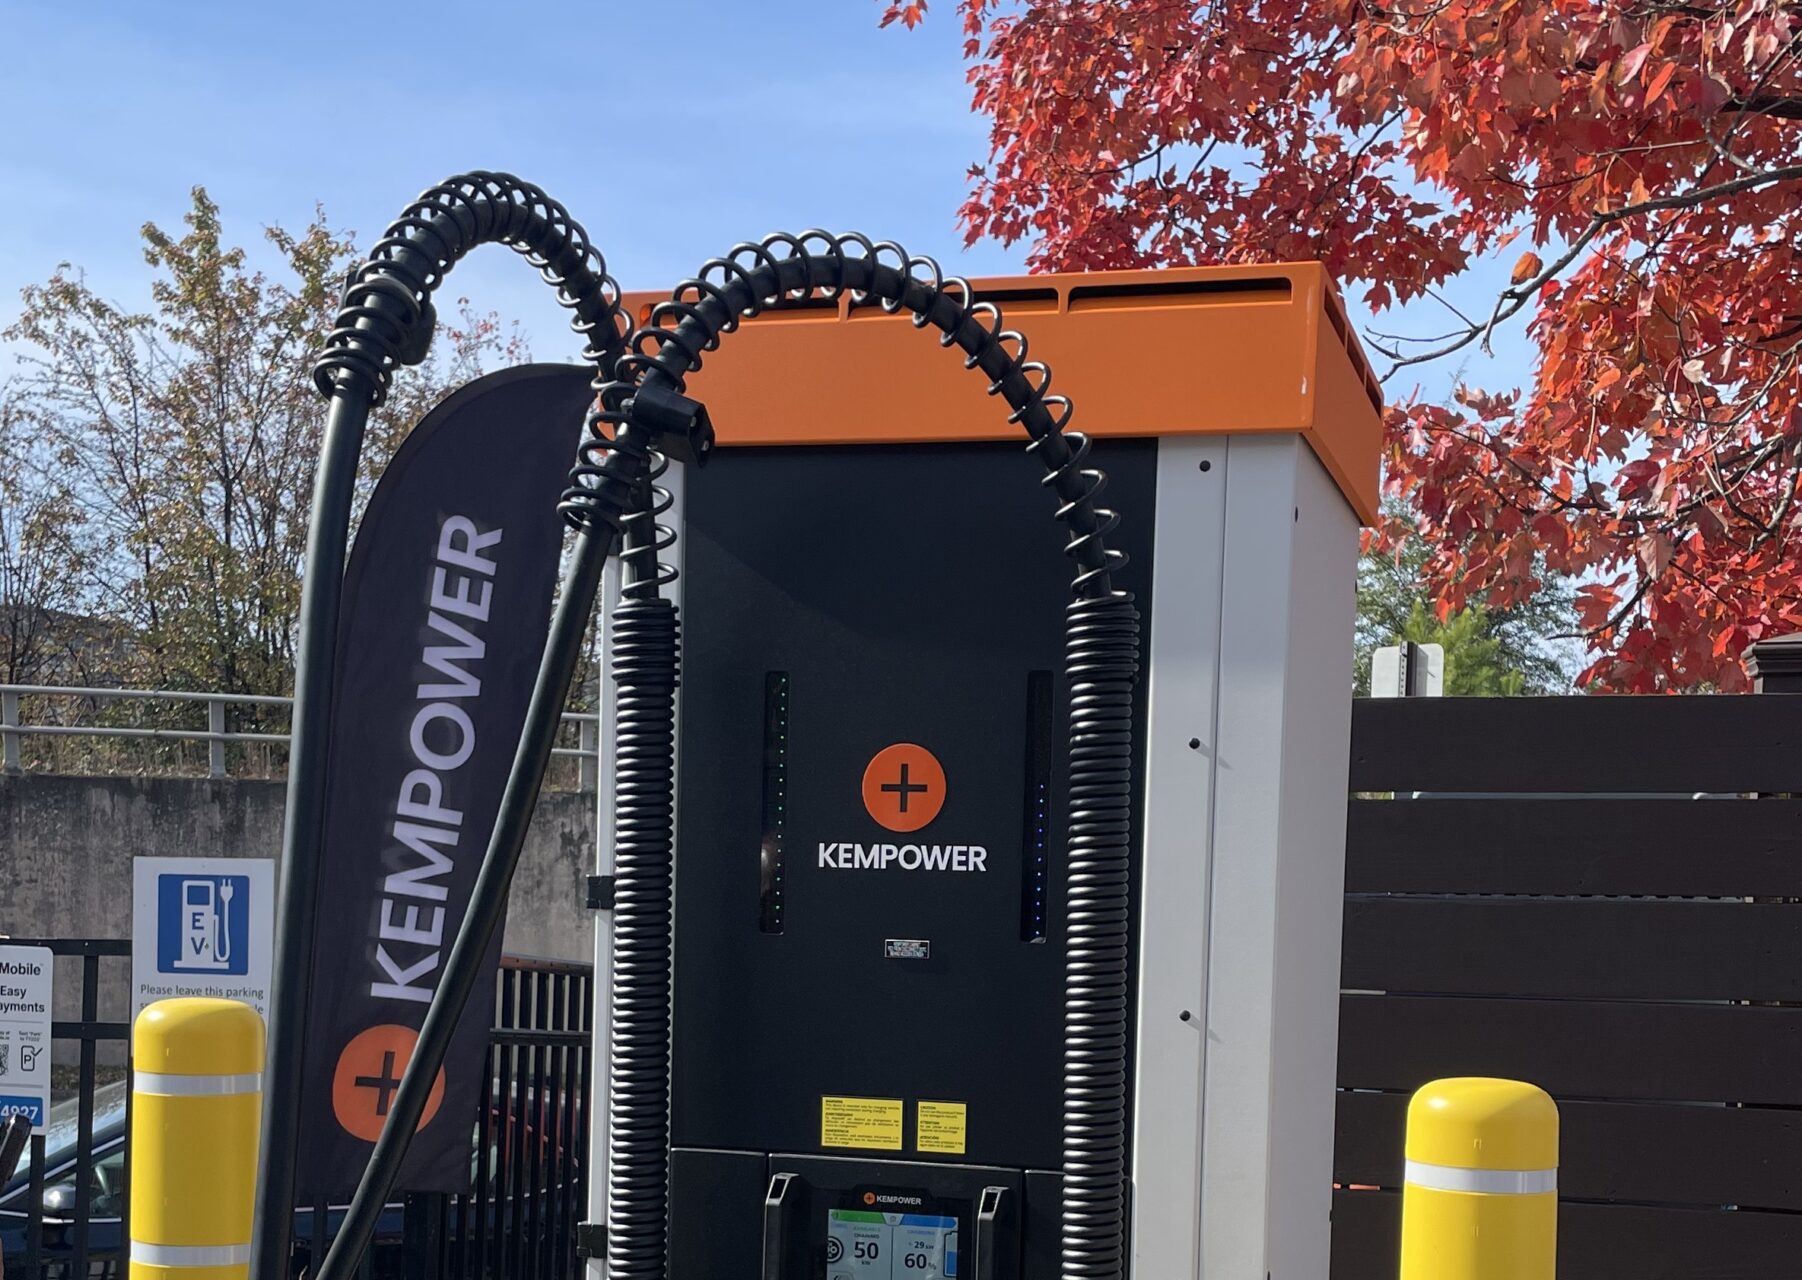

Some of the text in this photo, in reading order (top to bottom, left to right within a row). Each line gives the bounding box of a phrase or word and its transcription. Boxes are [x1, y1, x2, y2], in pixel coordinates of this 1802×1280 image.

[370, 514, 503, 1003] KEMPOWER
[818, 842, 987, 872] KEMPOWER
[0, 985, 27, 999] Easy
[140, 984, 264, 1000] Please leave this parking
[877, 1194, 921, 1206] KEMPOWER
[854, 1241, 879, 1260] 50
[914, 1240, 925, 1250] 29
[904, 1252, 927, 1269] 60
